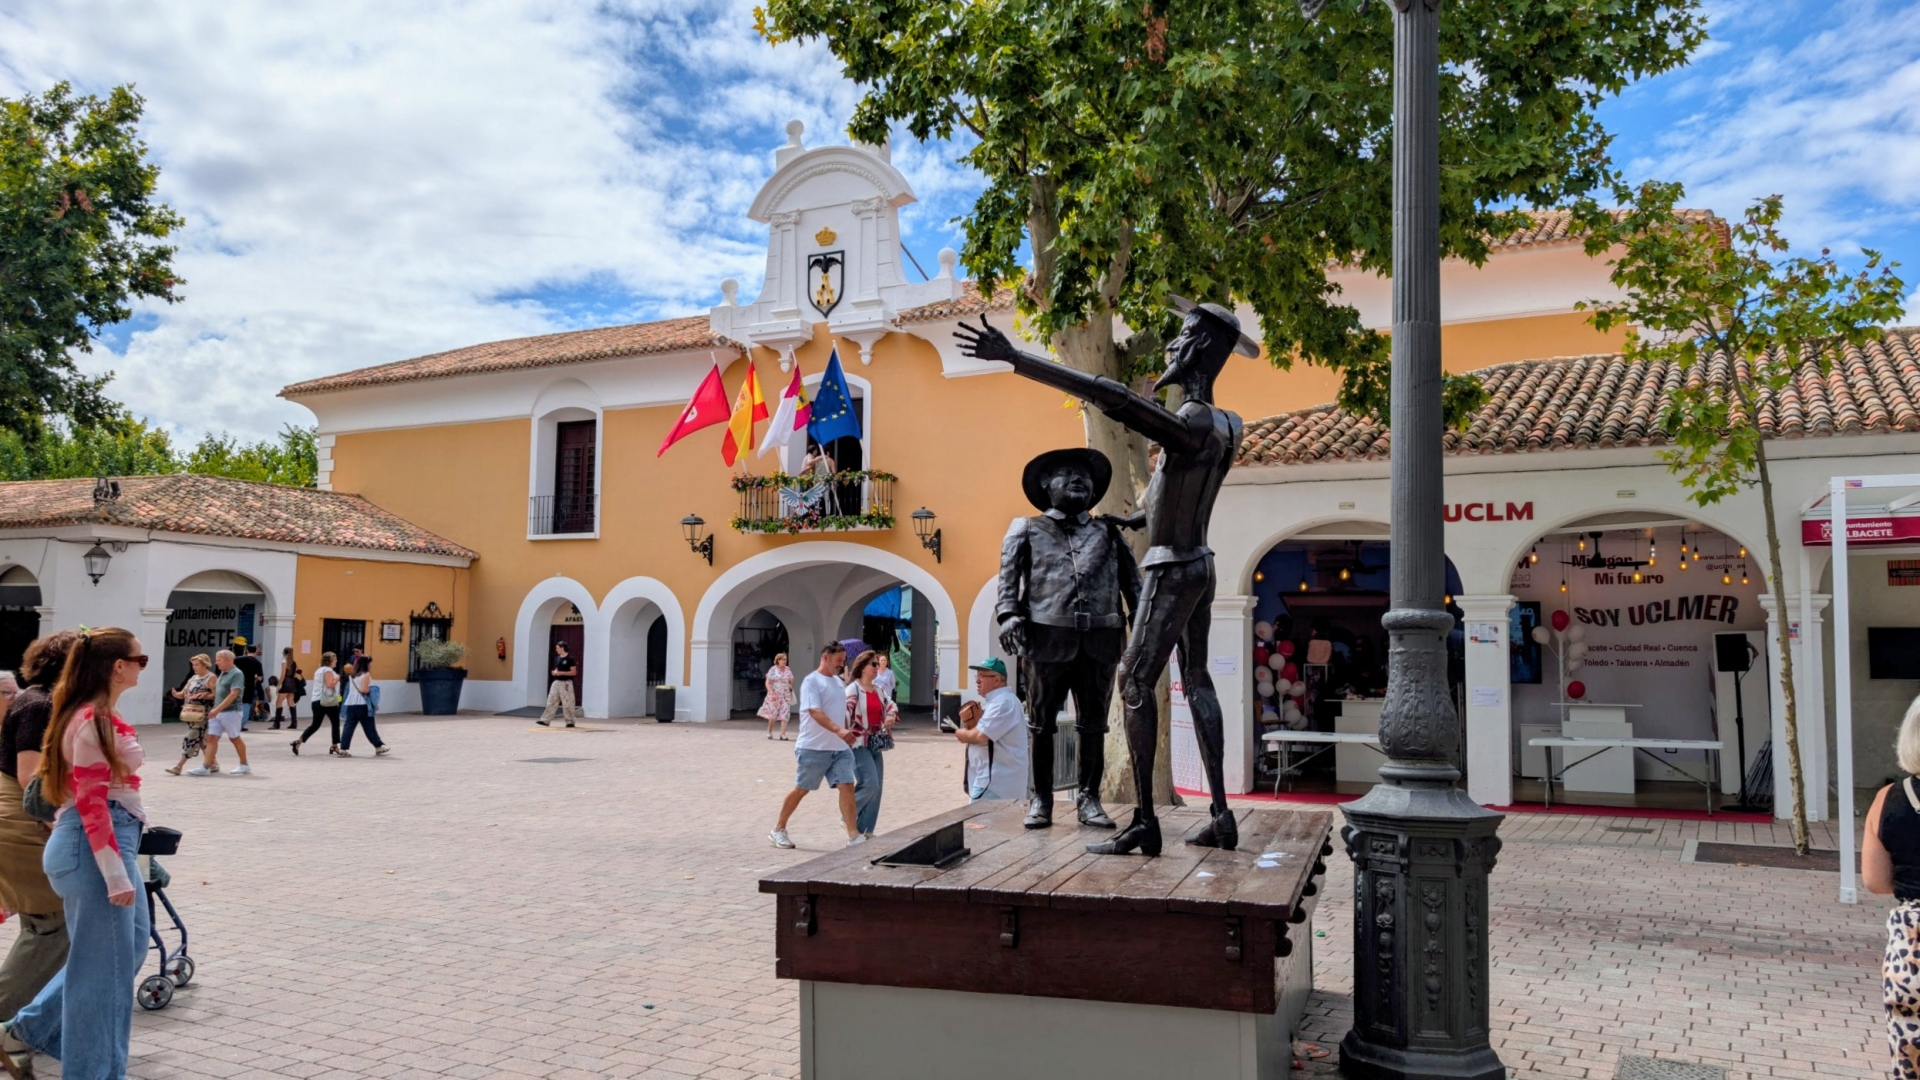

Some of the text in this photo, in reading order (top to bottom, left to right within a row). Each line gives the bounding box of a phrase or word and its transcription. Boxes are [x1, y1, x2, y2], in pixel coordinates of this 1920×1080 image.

[1443, 501, 1533, 522] UCLM
[1846, 529, 1893, 538] LBACETE
[1594, 571, 1664, 585] Mi fuuro
[166, 605, 236, 624] yuntamiento
[1573, 595, 1739, 627] SOY UCLMER
[1587, 643, 1698, 652] acete Ciudad Real Cuenca
[1583, 658, 1690, 667] Toledo Talavera Almadén
